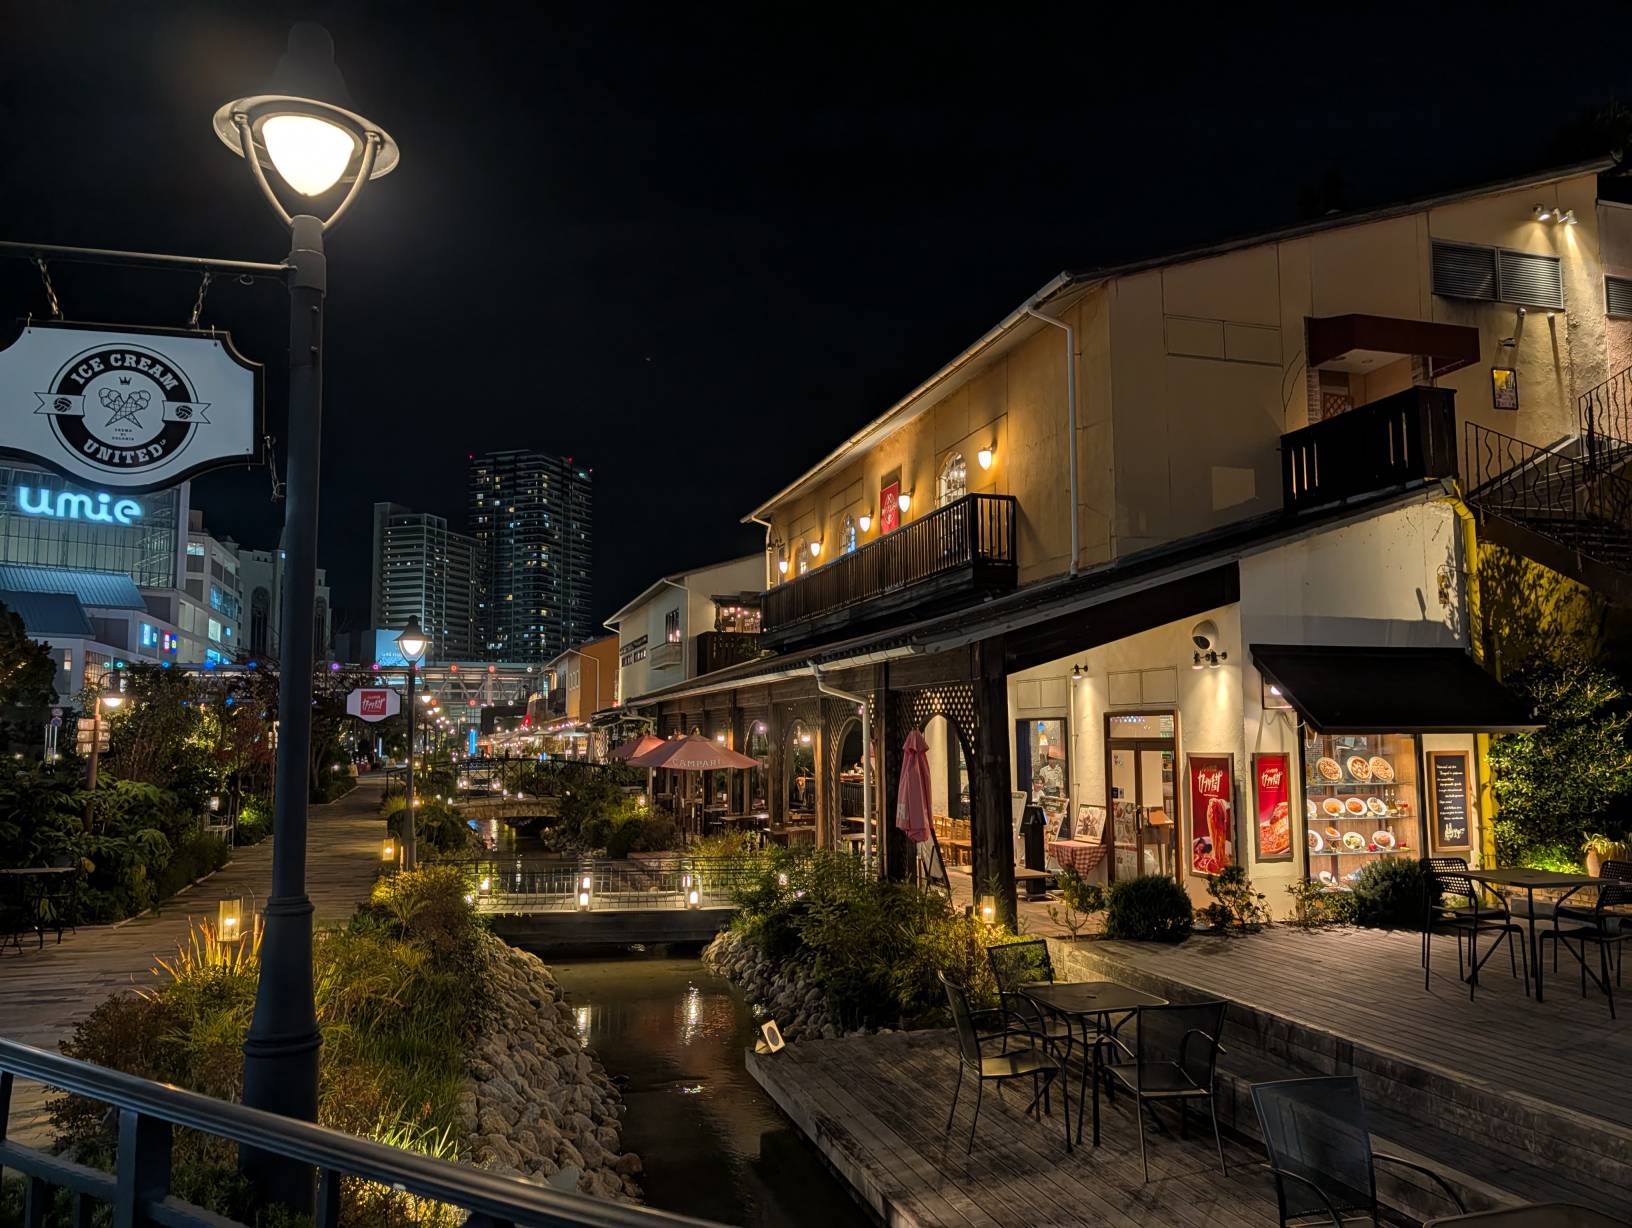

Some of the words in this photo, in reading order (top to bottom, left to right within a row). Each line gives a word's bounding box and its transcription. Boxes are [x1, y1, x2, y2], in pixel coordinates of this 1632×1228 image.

[71, 357, 105, 385] ICE
[110, 353, 179, 391] CREAM
[84, 439, 163, 464] UNITED
[18, 486, 143, 525] umie
